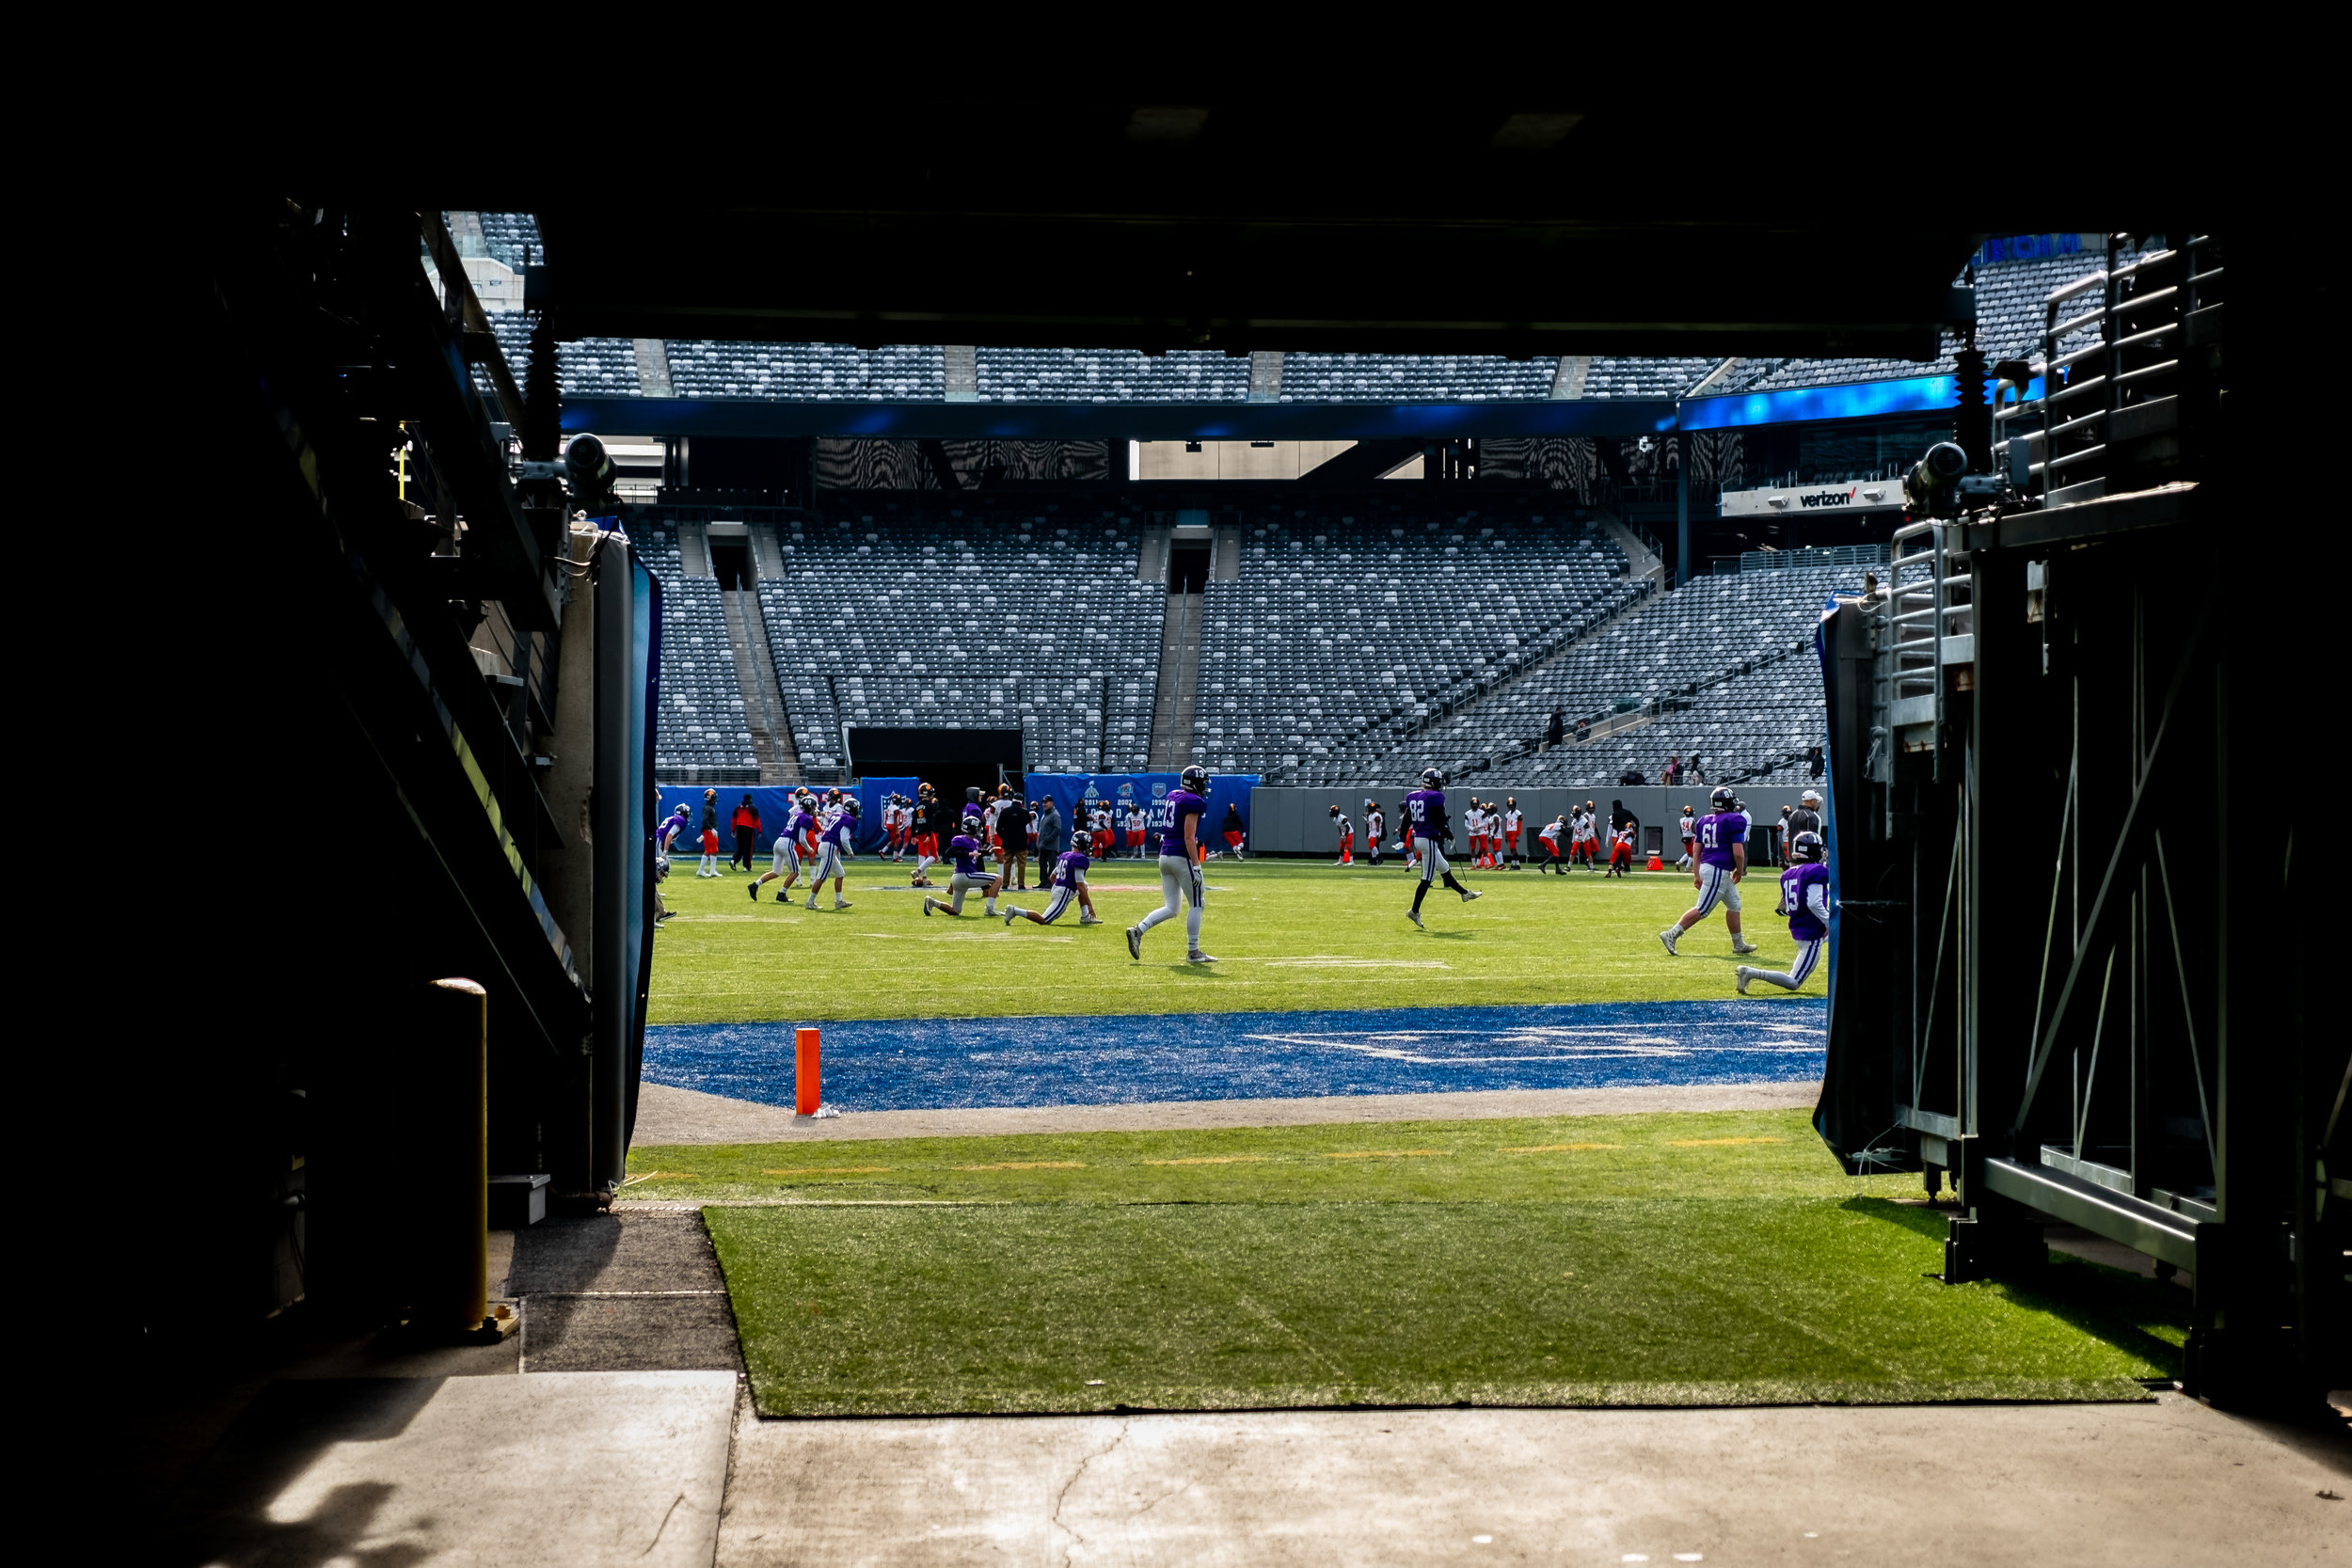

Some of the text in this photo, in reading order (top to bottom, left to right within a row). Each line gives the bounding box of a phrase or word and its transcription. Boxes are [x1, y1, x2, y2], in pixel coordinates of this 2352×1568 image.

[1800, 490, 1851, 508] verizon
[1195, 769, 1205, 779] 13
[1162, 800, 1176, 829] 13
[1409, 800, 1425, 822] 82
[1702, 823, 1719, 848] 61
[1783, 879, 1799, 911] 15
